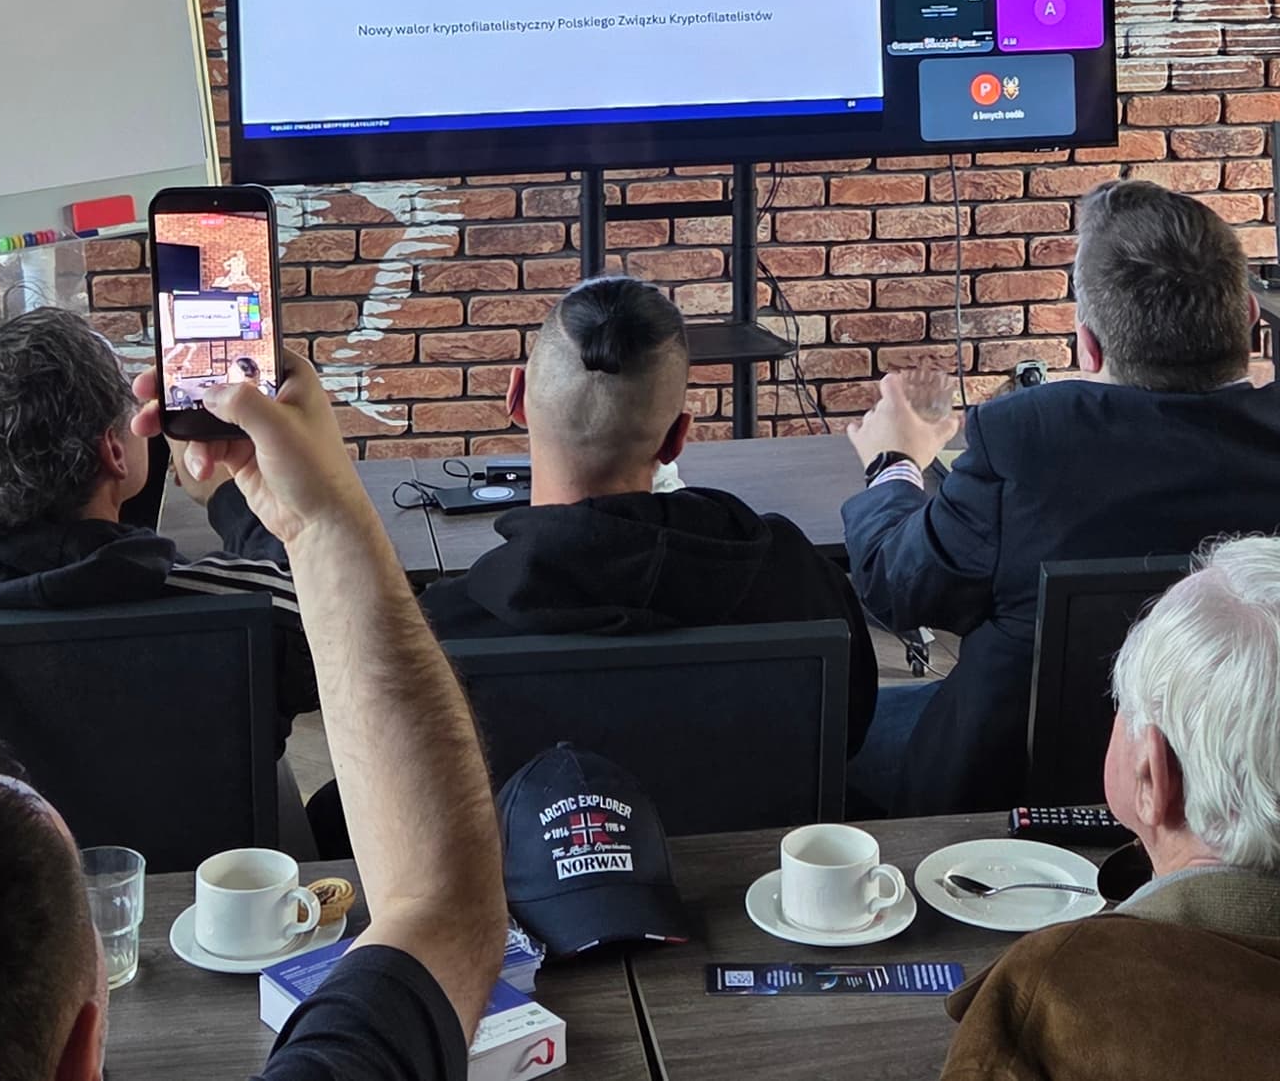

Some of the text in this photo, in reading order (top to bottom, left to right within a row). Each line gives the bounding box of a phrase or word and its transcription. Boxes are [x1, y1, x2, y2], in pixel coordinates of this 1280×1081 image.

[1043, 1, 1057, 16] A
[358, 11, 773, 37] Nowy walor kryptofilatelistyczny Polskiego Związku Kryptofilatelistów
[980, 82, 992, 97] P
[539, 794, 632, 826] ARCTIC EXPLORER
[561, 855, 628, 877] NORWAY
